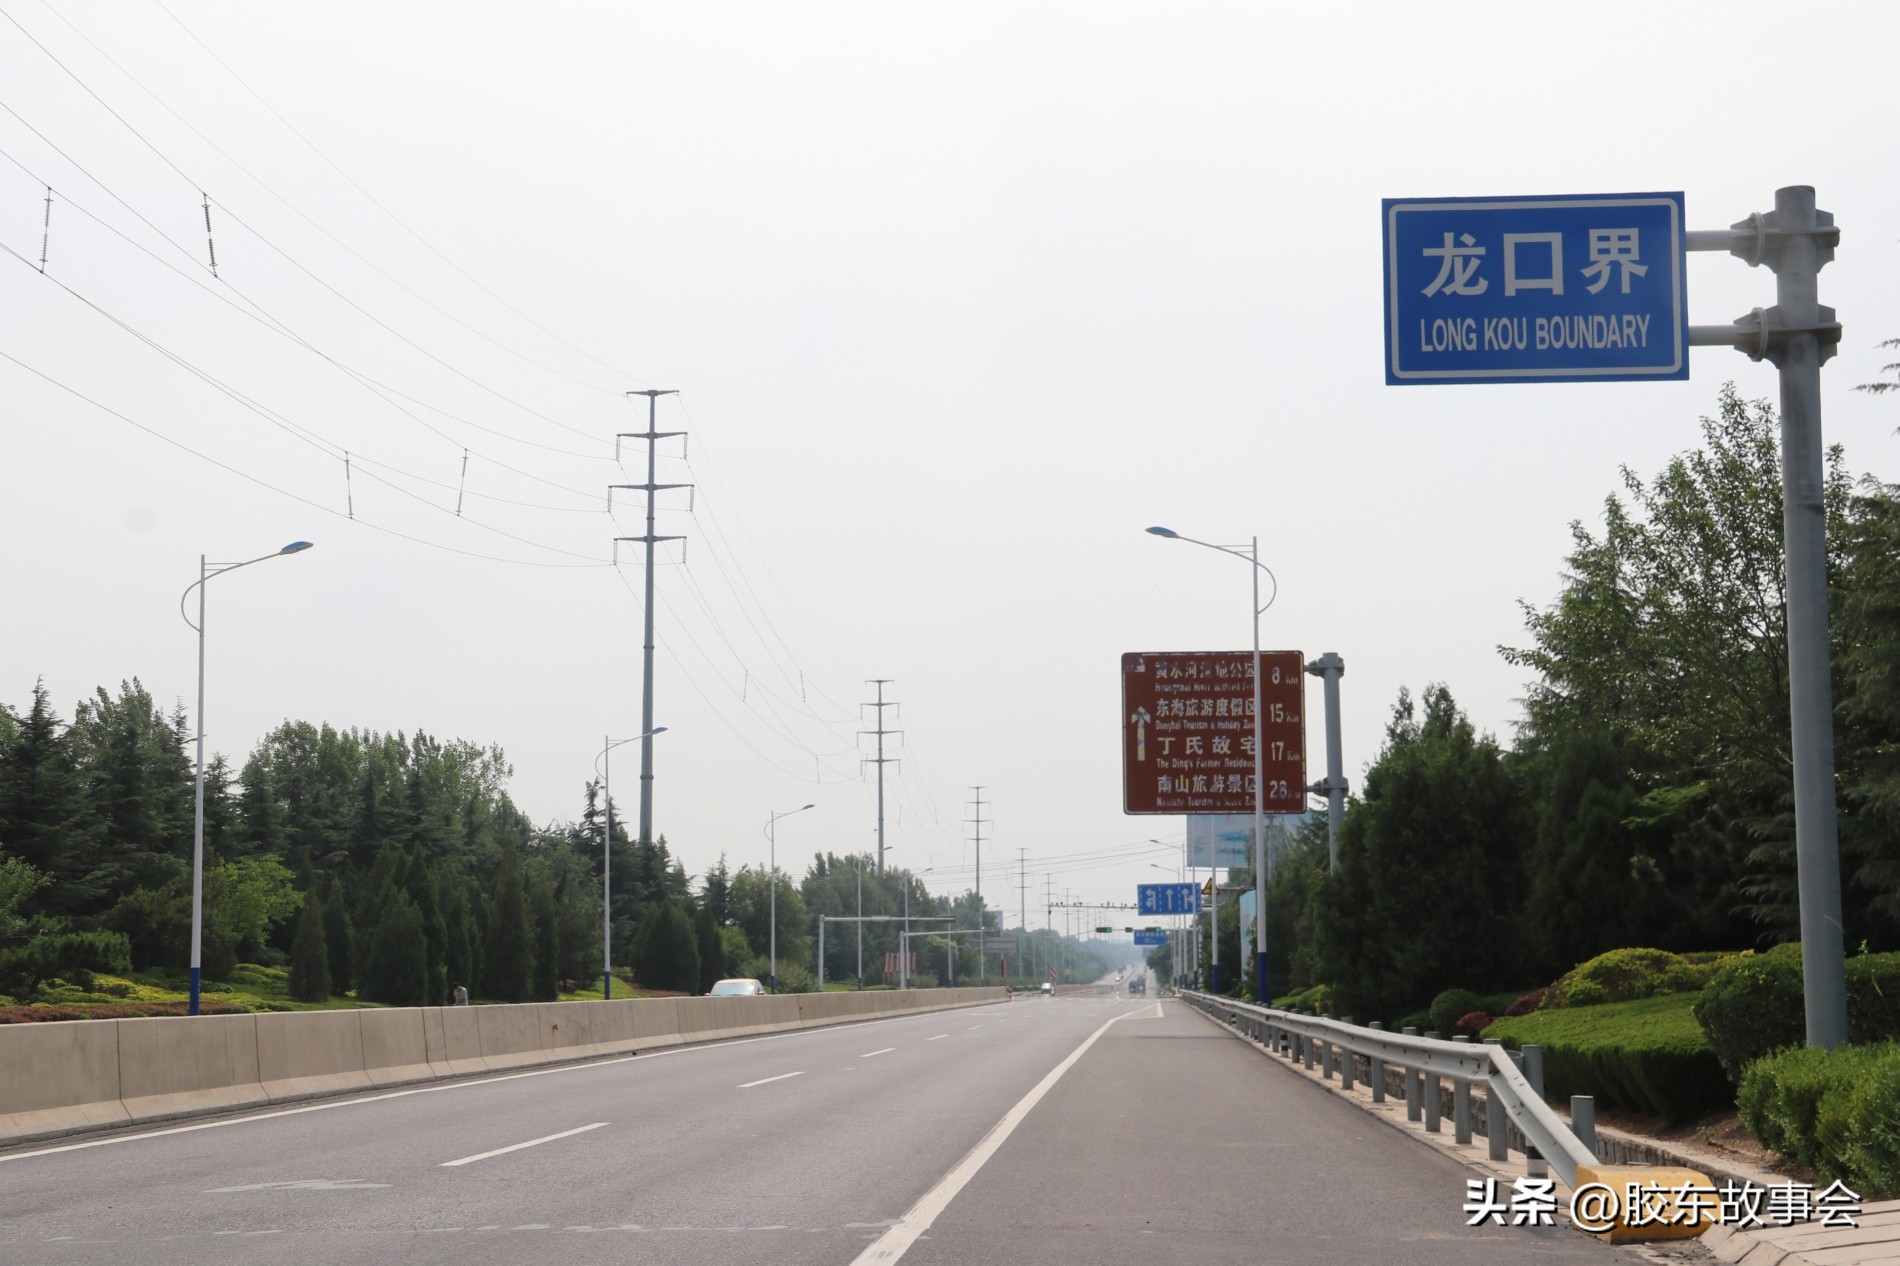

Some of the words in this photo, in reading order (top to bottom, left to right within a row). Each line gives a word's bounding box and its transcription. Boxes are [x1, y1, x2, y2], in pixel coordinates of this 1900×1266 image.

[1420, 227, 1649, 298] 龙口界
[1420, 318, 1477, 352] LONG
[1484, 317, 1527, 351] KOU
[1535, 314, 1650, 350] BOUNDARY
[1272, 667, 1280, 684] 8
[1156, 698, 1256, 717] 东海旅游度假区
[1270, 703, 1284, 723] 15
[1183, 719, 1208, 729] Tourism
[1157, 736, 1256, 755] 丁氏故宅
[1271, 741, 1284, 761] 17
[1156, 758, 1169, 768] The
[1172, 758, 1193, 770] Ding's
[1196, 758, 1221, 768] Former
[1224, 757, 1256, 768] Residenc
[1157, 774, 1256, 793] 南山旅游景区
[1269, 780, 1287, 799] 28
